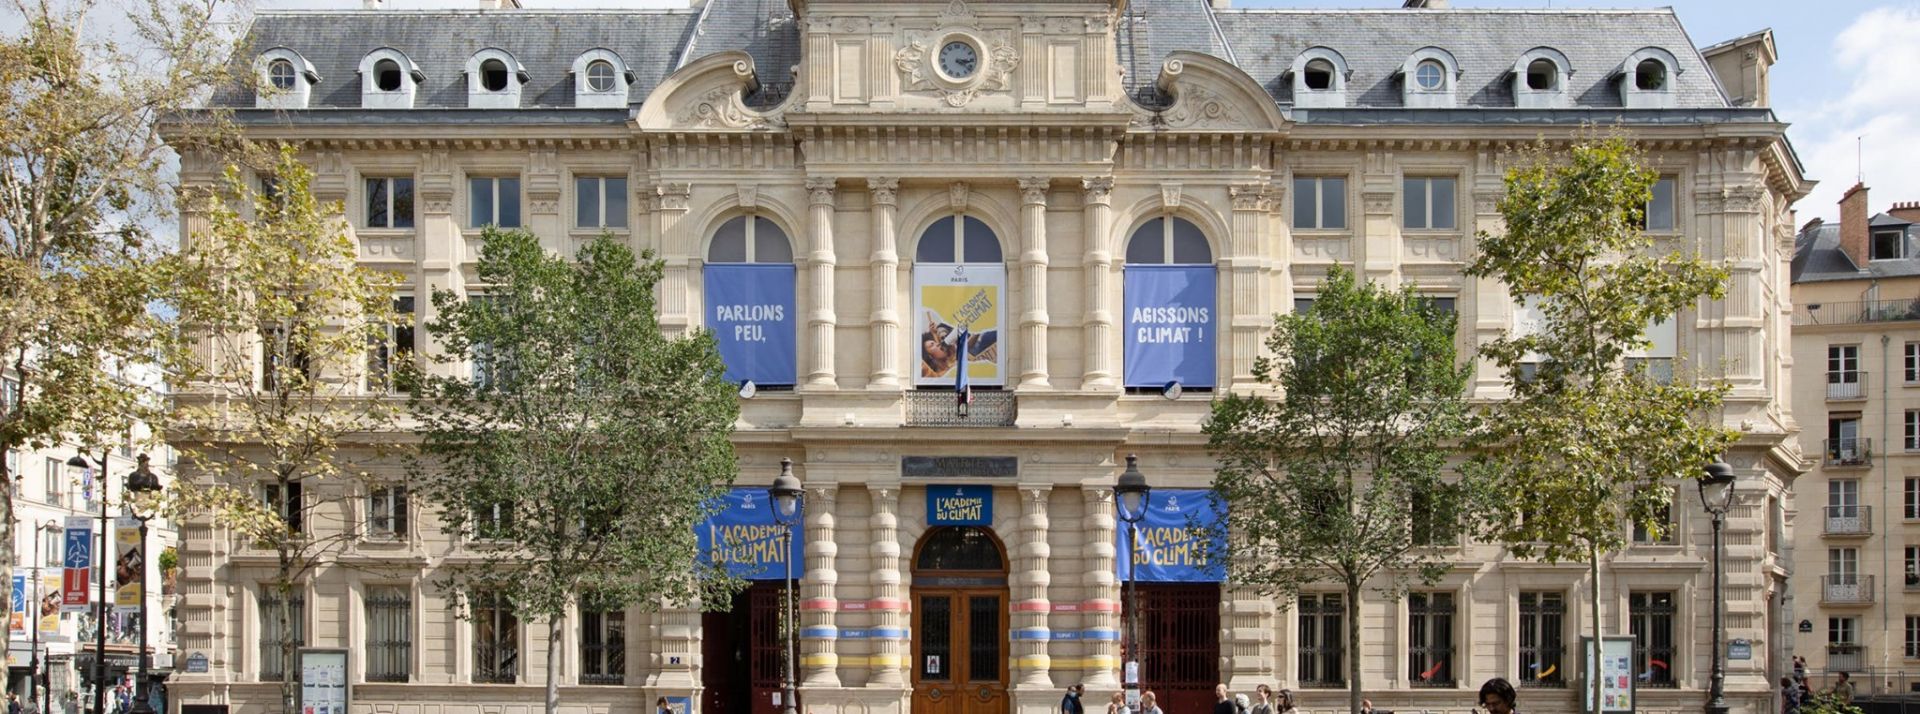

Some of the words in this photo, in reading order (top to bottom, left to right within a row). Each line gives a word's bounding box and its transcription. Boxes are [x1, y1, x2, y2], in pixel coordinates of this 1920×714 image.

[716, 304, 784, 321] PARLONS
[1131, 306, 1209, 323] AGISSONS
[735, 324, 766, 344] PEU,
[1137, 327, 1192, 343] CLIMAT
[1198, 327, 1203, 342] !
[936, 511, 948, 520] DU
[949, 504, 982, 520] CLIMAT
[732, 536, 785, 563] CLIMAT
[1134, 549, 1151, 565] DU
